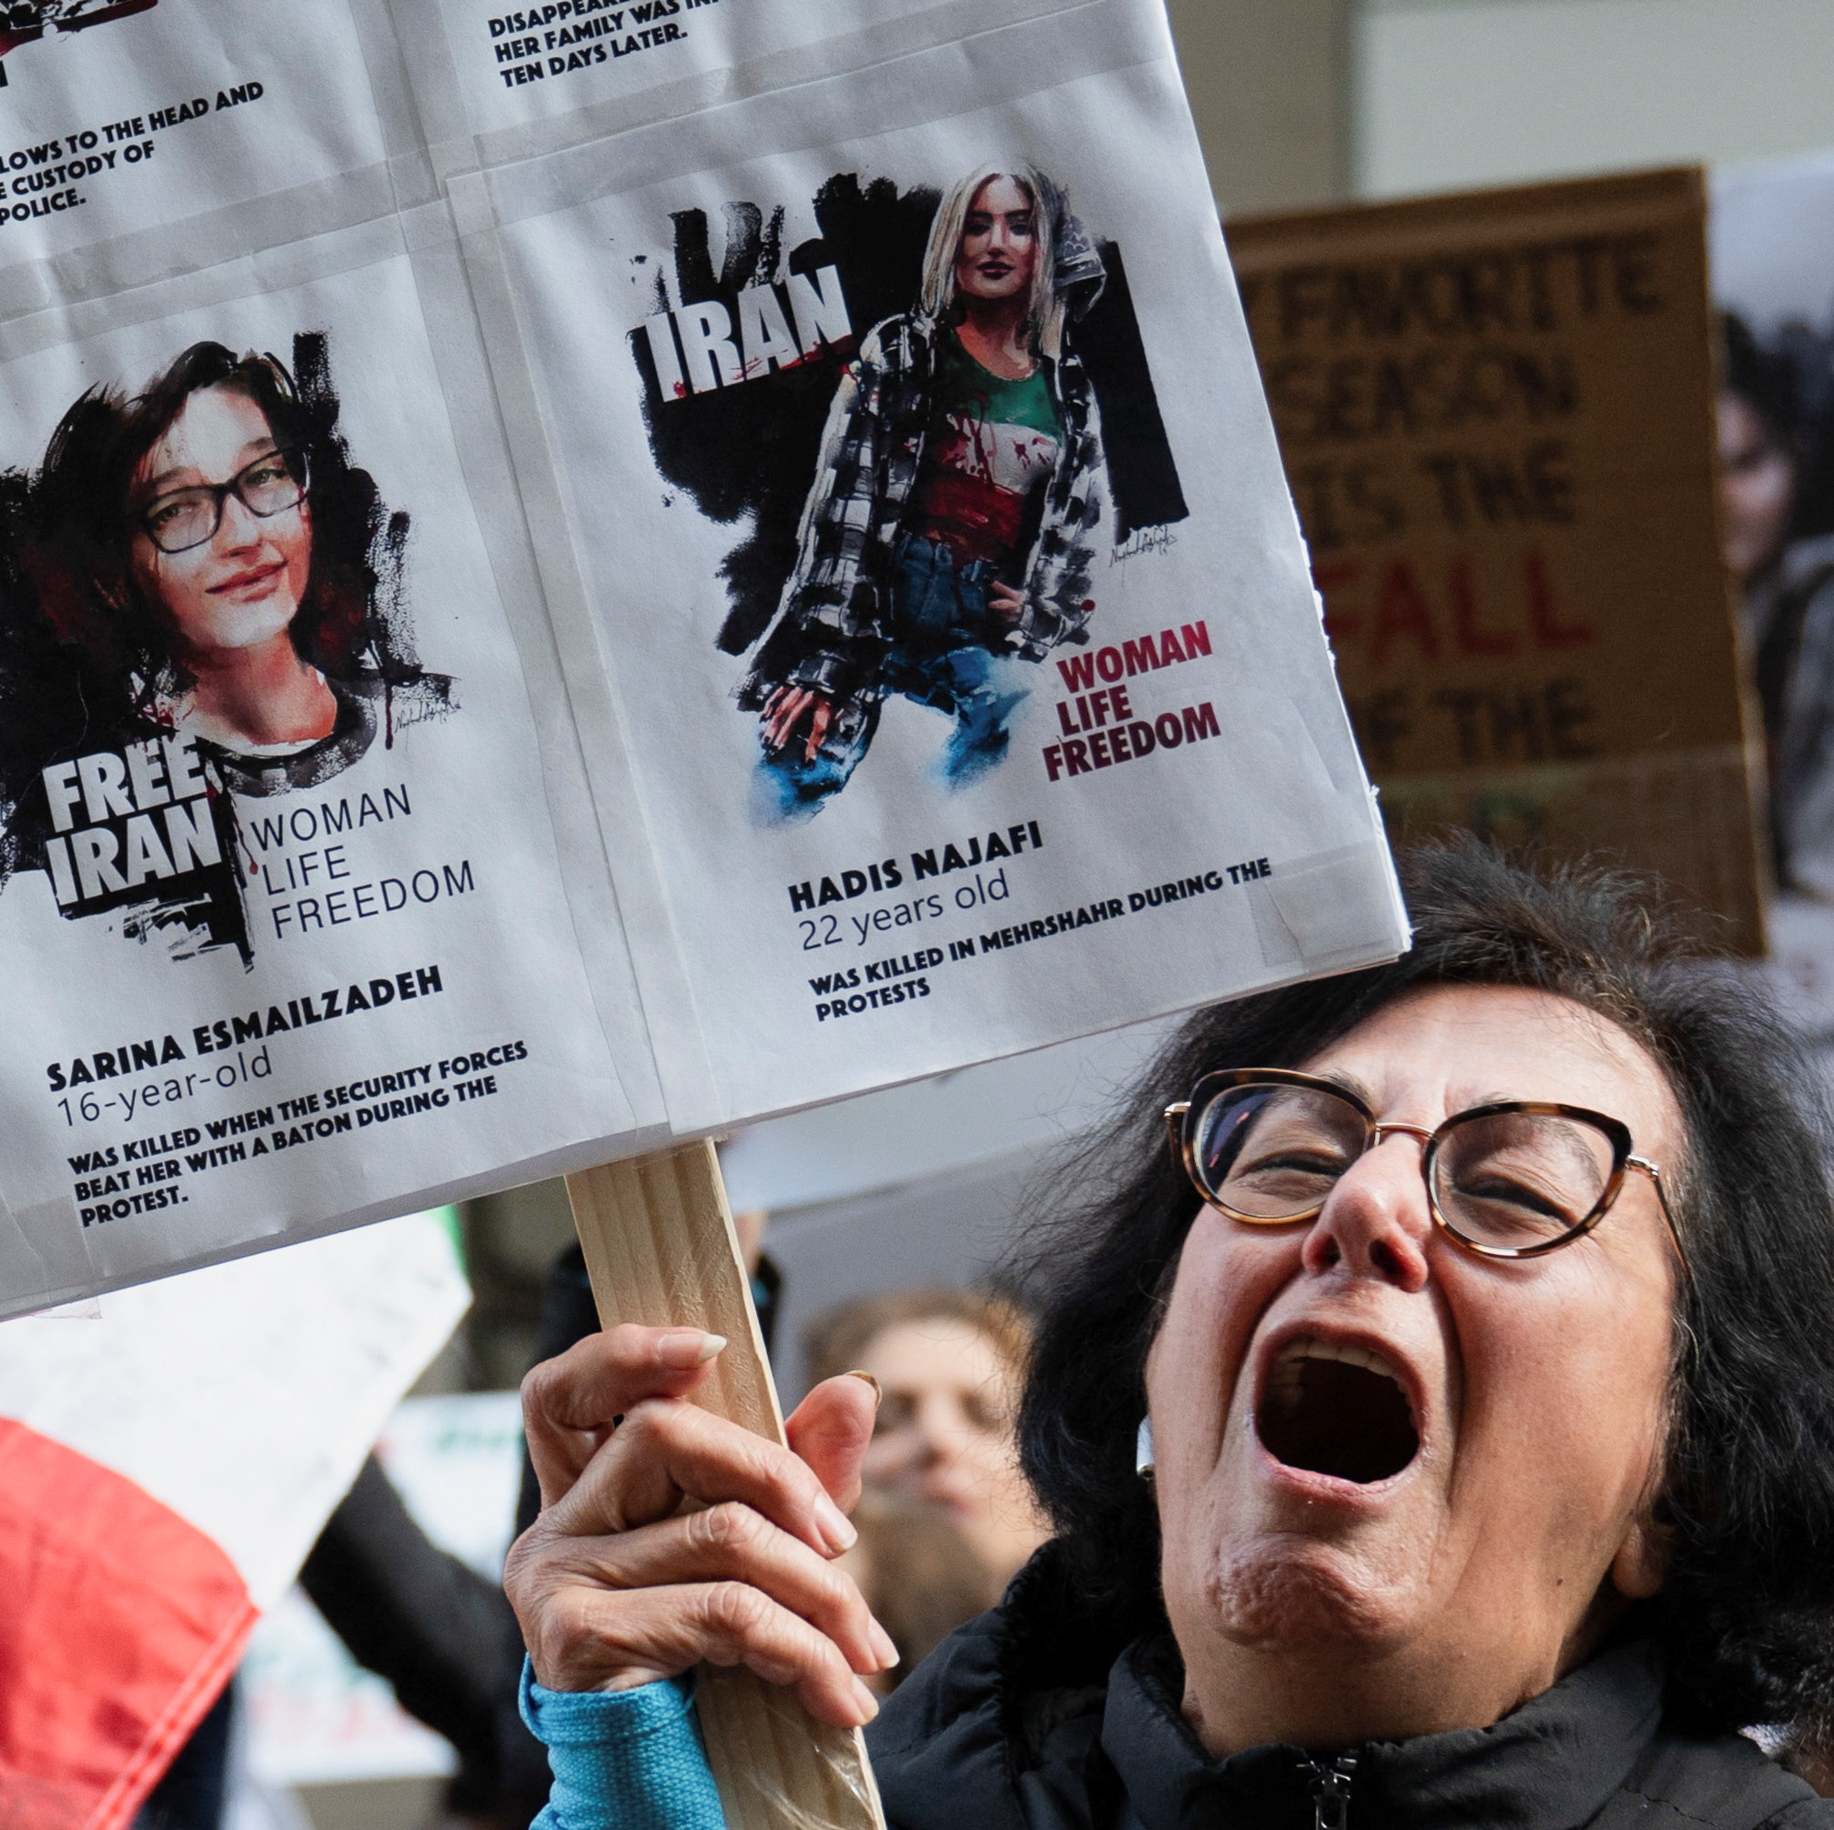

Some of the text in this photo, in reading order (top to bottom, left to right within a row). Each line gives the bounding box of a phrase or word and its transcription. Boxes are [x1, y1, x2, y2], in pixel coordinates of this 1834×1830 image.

[488, 0, 637, 38] DISAPPEA
[495, 38, 541, 63] HER
[544, 11, 624, 50] FAMILY
[629, 0, 680, 24] WAS
[500, 23, 687, 87] TEN DAYS LATER.
[65, 131, 98, 154] TO
[102, 117, 145, 143] THE
[148, 98, 209, 131] HEAD
[216, 83, 263, 111] AND
[12, 150, 116, 195] CUSTODY
[124, 140, 154, 163] OF
[1280, 232, 1664, 340] FAVORITE
[642, 266, 851, 401] IRAN
[1273, 348, 1578, 443] SEASON
[1304, 440, 1575, 547] IS THE
[1314, 551, 1595, 666] FALL
[1057, 621, 1212, 694] WOMAN
[1043, 702, 1221, 781] FREEDOM
[1056, 686, 1133, 736] LIFE
[1432, 676, 1595, 762] THE
[42, 734, 209, 832] FREE
[251, 784, 412, 850] WOMAN
[45, 799, 223, 905] IRAN
[263, 846, 350, 895] LIFE
[788, 821, 1042, 912] HADIS NAJAFI
[272, 860, 475, 939] FREEDOM
[799, 868, 1009, 950] 22 years old
[809, 858, 1272, 994] WAS KILLED IN MEHRSHAHR DURING THE
[47, 965, 442, 1091] SARINA ESMAILZADEH
[816, 977, 930, 1021] PROTESTS
[57, 1045, 273, 1126] 16-year-old
[67, 1041, 527, 1174] WAS KILLED WHEN THE SECURITY FORCES
[75, 1076, 497, 1201] BEAT HER WITH A BATON DURING THE
[80, 1188, 188, 1227] PROTEST.
